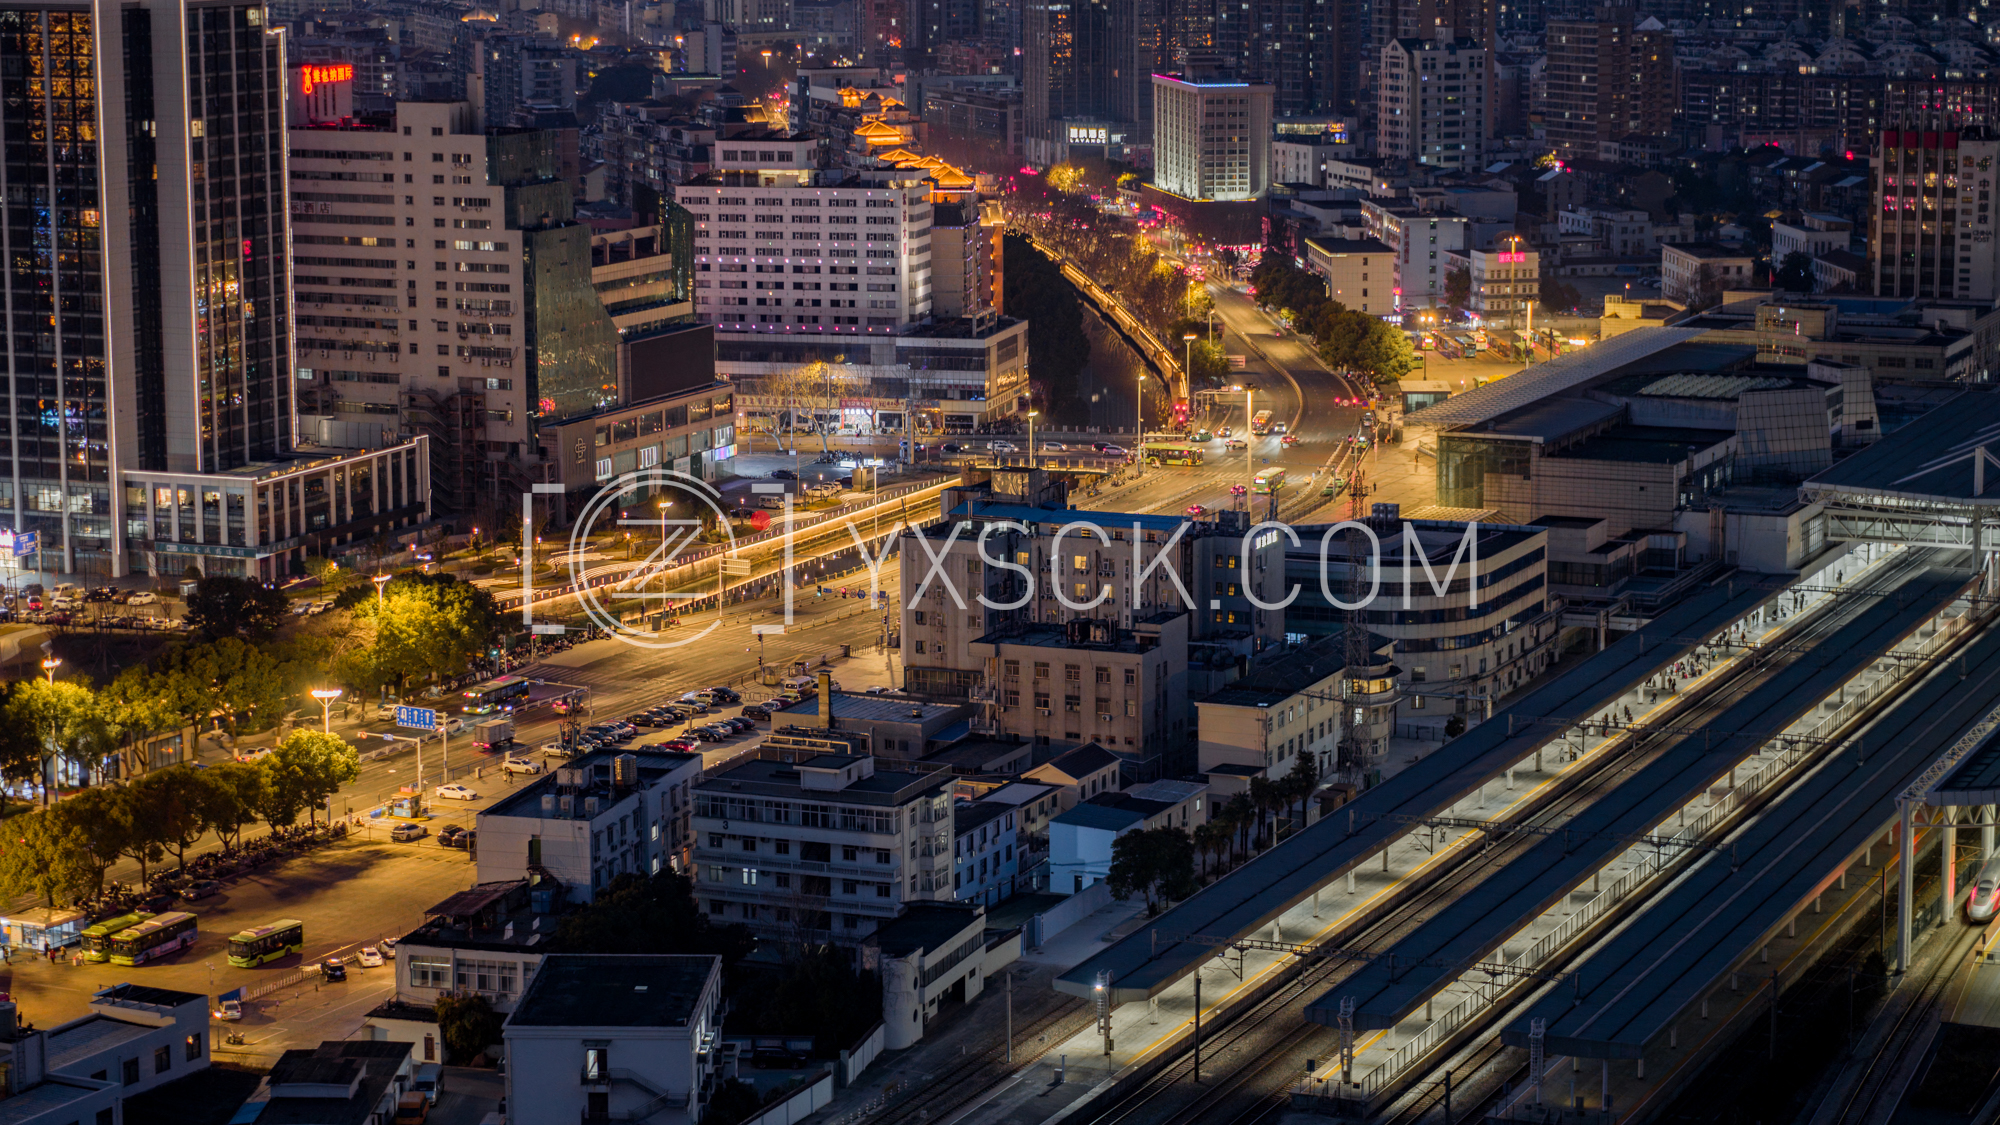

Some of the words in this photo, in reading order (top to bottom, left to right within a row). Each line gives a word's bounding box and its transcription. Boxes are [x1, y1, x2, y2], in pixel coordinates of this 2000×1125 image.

[1977, 178, 1990, 224] 中国邮政
[722, 820, 729, 830] 3
